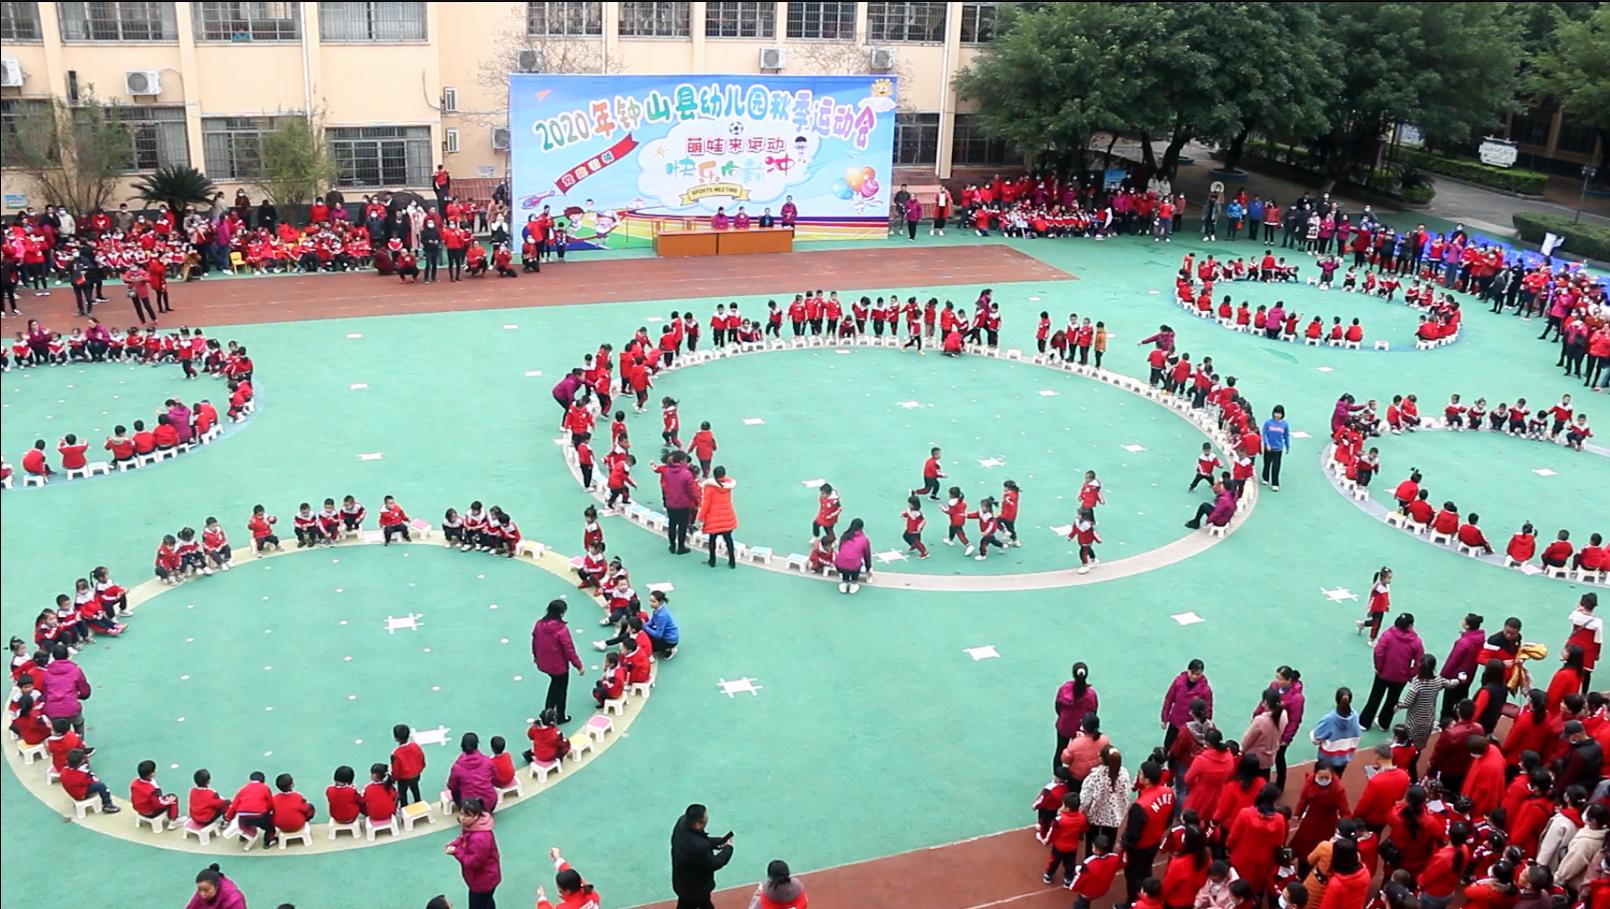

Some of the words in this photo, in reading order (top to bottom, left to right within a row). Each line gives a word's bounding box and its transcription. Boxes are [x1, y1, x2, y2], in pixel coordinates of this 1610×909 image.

[533, 84, 876, 150] 2020年钟山县幼儿园秋季运动会
[687, 137, 785, 154] 萌娃来运动
[665, 153, 795, 182] 快乐向前冲
[691, 187, 713, 196] SPORTS
[714, 186, 738, 194] MEETING
[1151, 794, 1173, 812] NIKE
